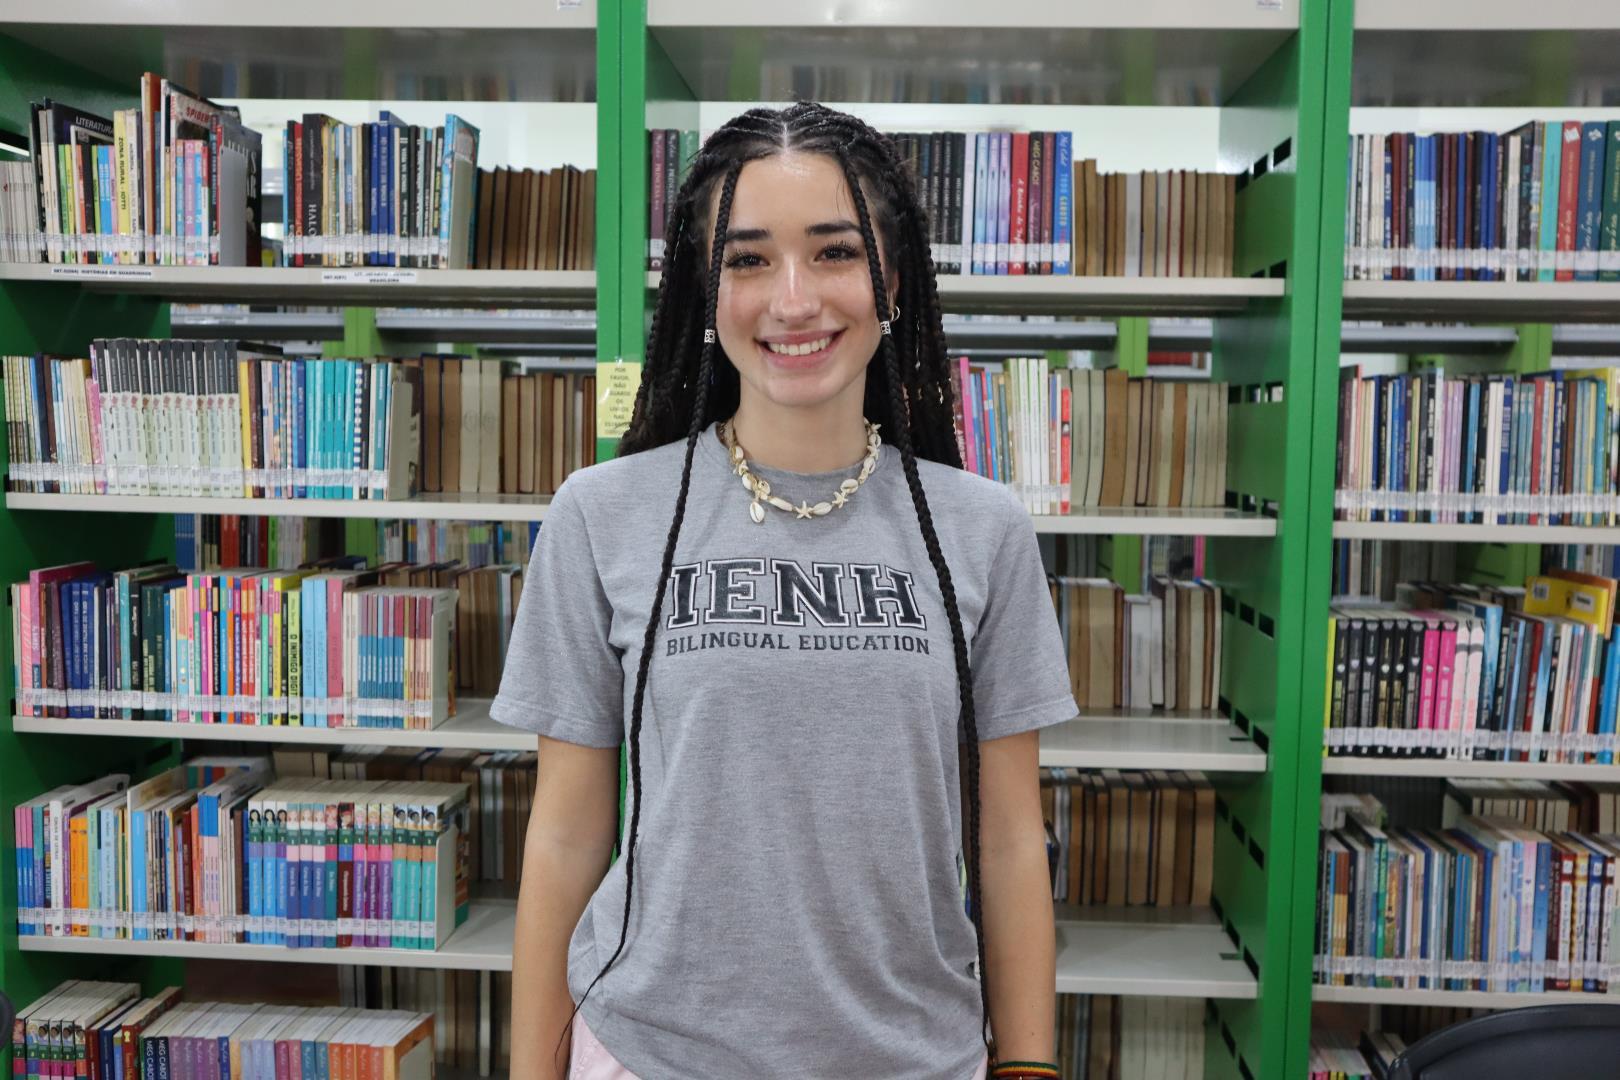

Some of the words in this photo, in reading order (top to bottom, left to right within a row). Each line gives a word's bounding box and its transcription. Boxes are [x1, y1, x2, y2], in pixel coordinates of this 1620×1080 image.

[308, 204, 316, 236] HALO
[667, 558, 927, 630] IENH
[666, 632, 790, 656] BILINGUAL
[800, 634, 930, 655] EDUCATION
